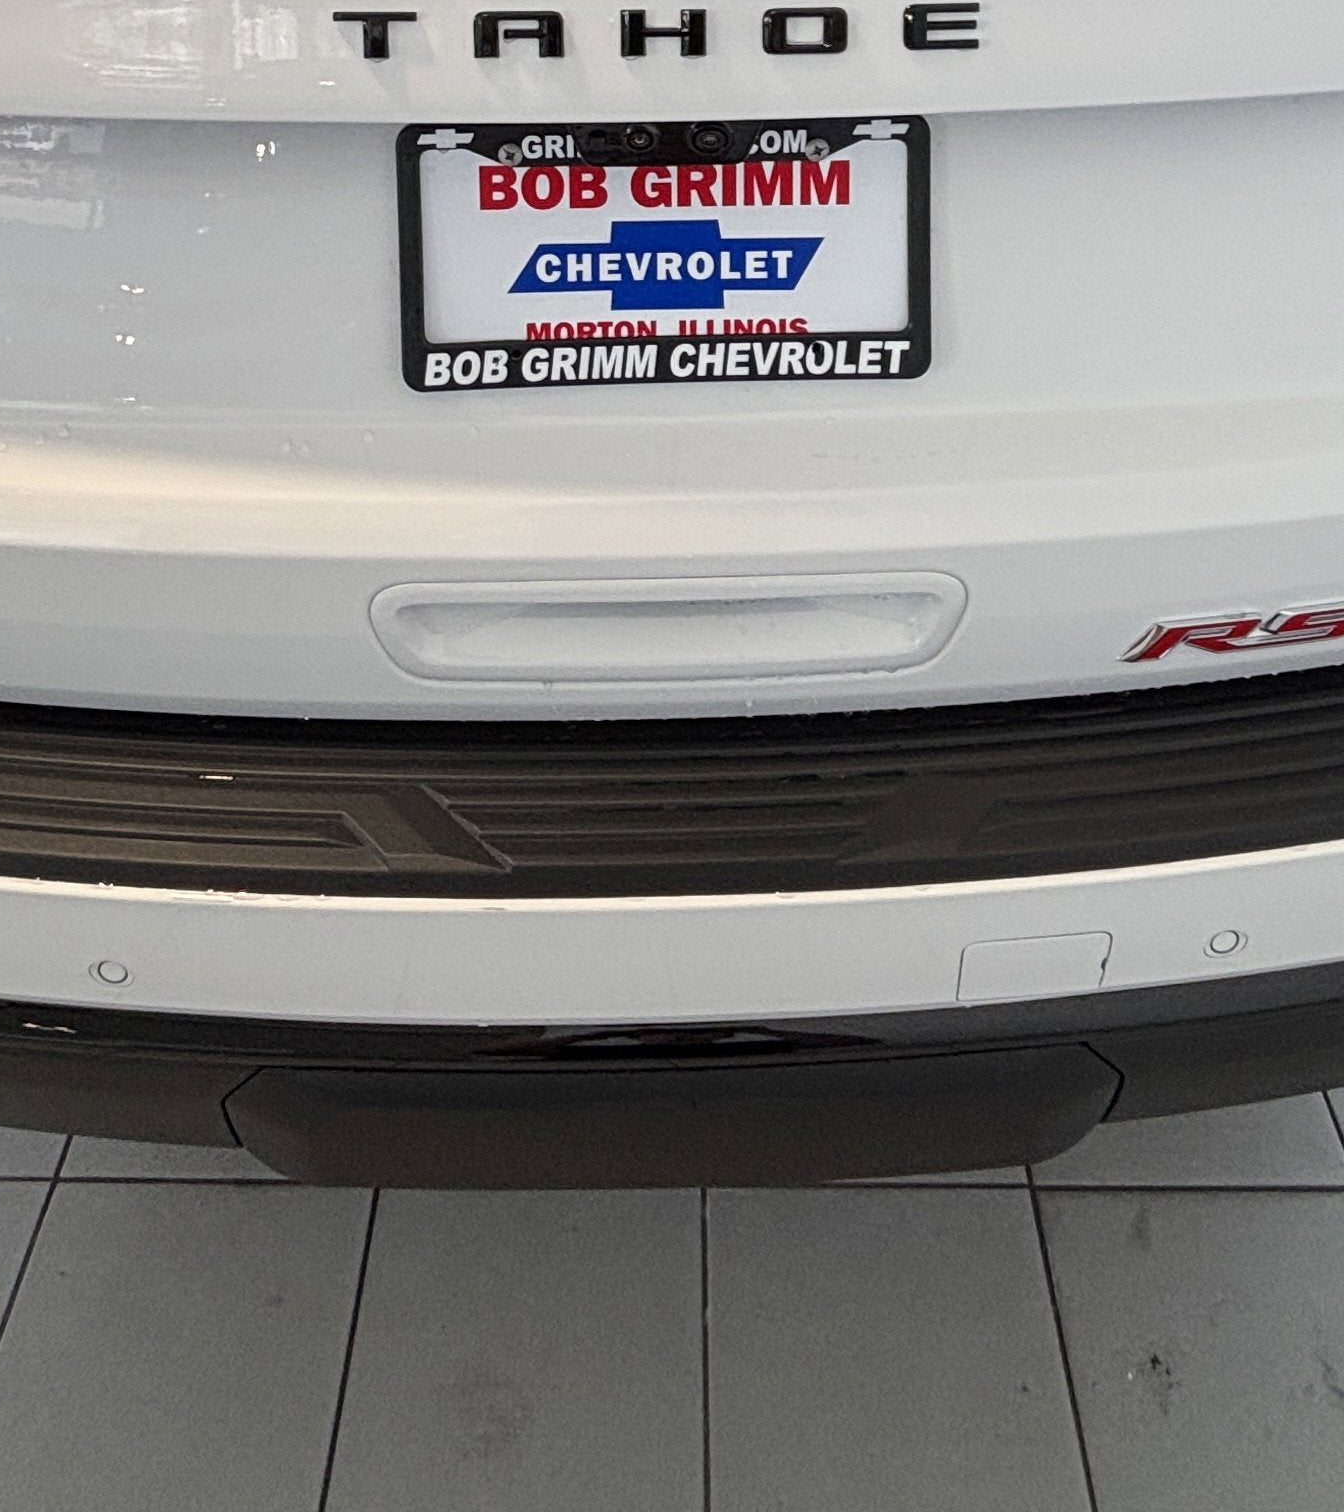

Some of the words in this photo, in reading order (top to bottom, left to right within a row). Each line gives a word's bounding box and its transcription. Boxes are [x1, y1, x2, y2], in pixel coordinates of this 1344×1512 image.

[333, 2, 980, 59] TAHOE
[521, 134, 579, 159] GRI
[479, 166, 608, 210] BOB
[630, 160, 850, 208] GRIMM
[535, 251, 794, 284] CHEVROLET
[526, 321, 657, 341] MORTON
[678, 318, 808, 335] ILLINOIS
[424, 351, 508, 387] BOB
[521, 345, 658, 381] GRIMM
[669, 341, 910, 377] CHEVROLET
